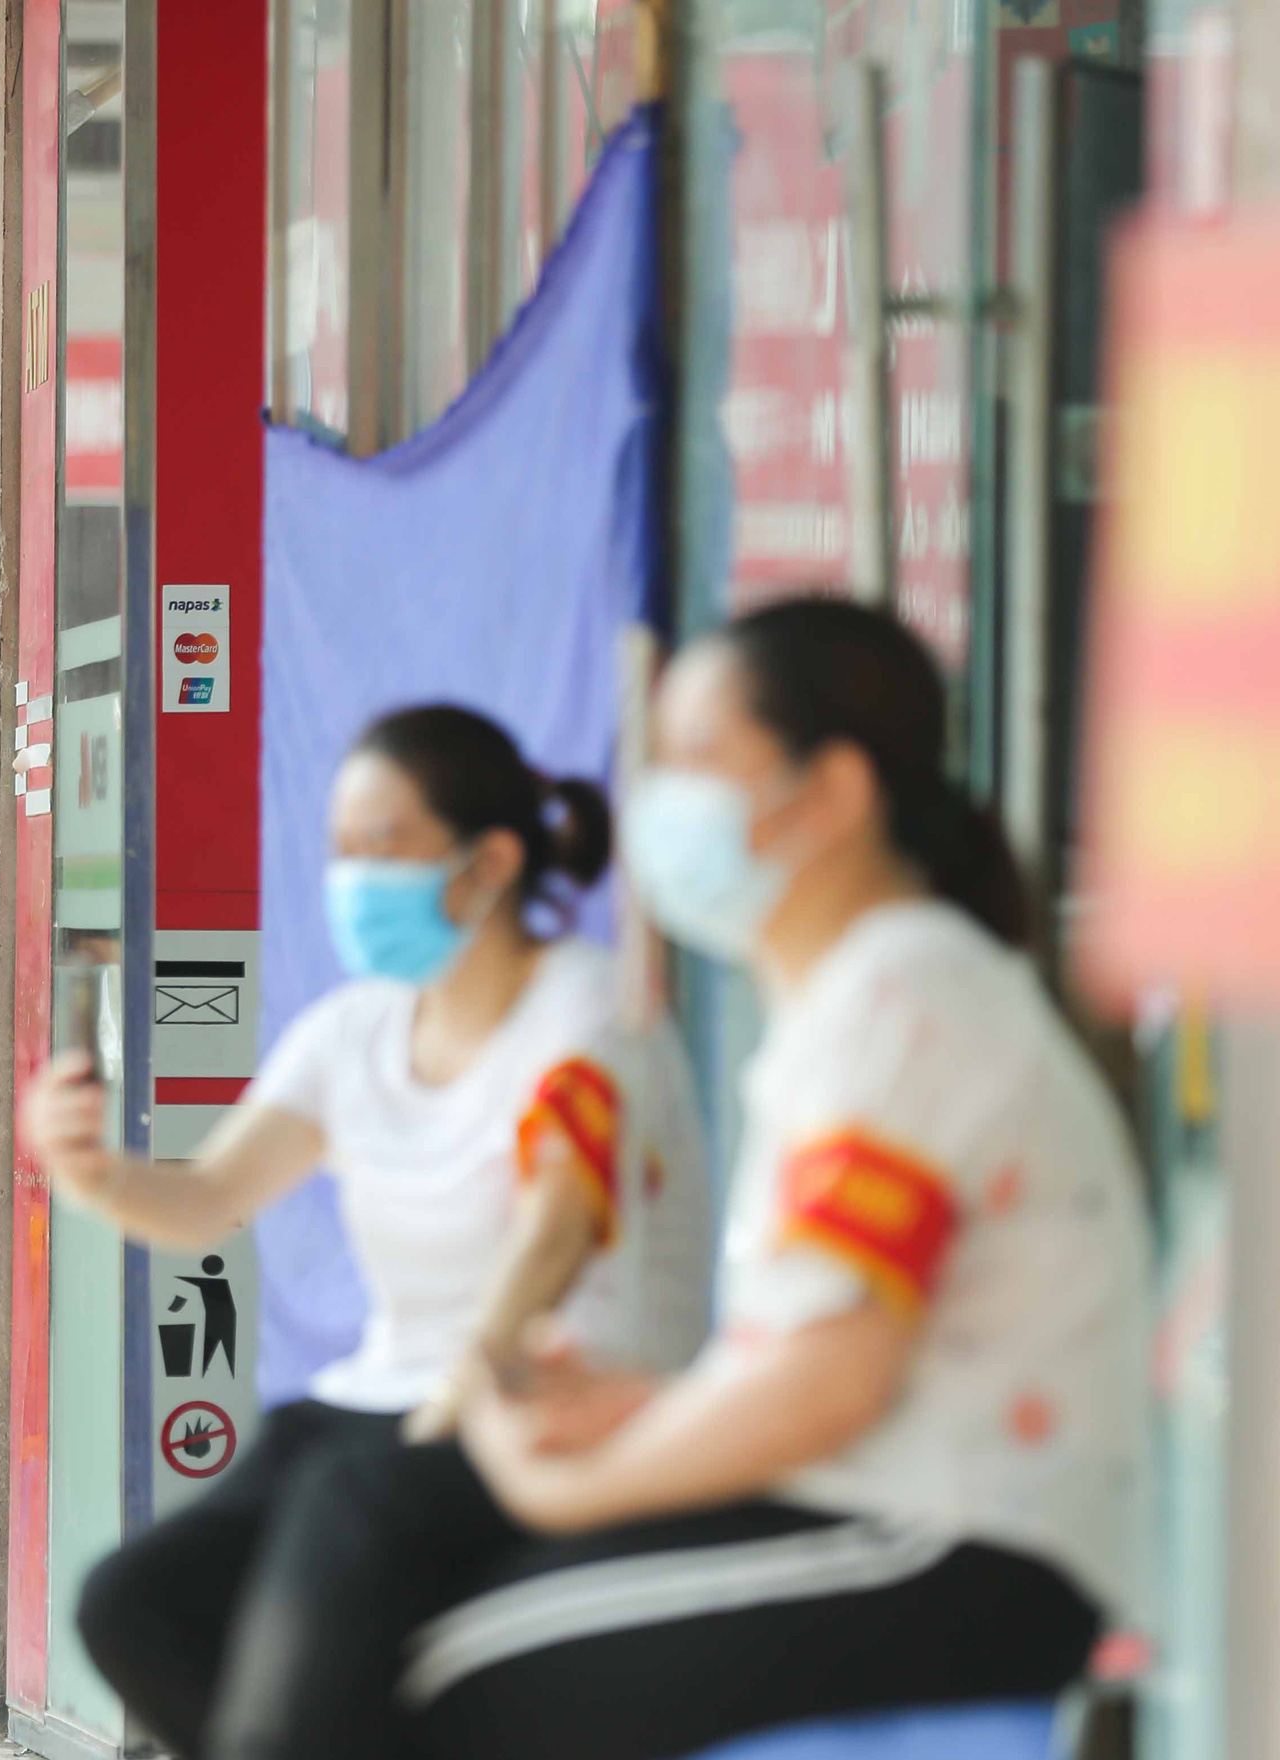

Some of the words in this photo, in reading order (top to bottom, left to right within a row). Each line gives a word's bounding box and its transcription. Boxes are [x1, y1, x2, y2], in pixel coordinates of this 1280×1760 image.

[25, 281, 50, 394] ATM
[169, 600, 210, 613] napas
[175, 644, 218, 653] MasterCard
[182, 684, 211, 692] UnionPay
